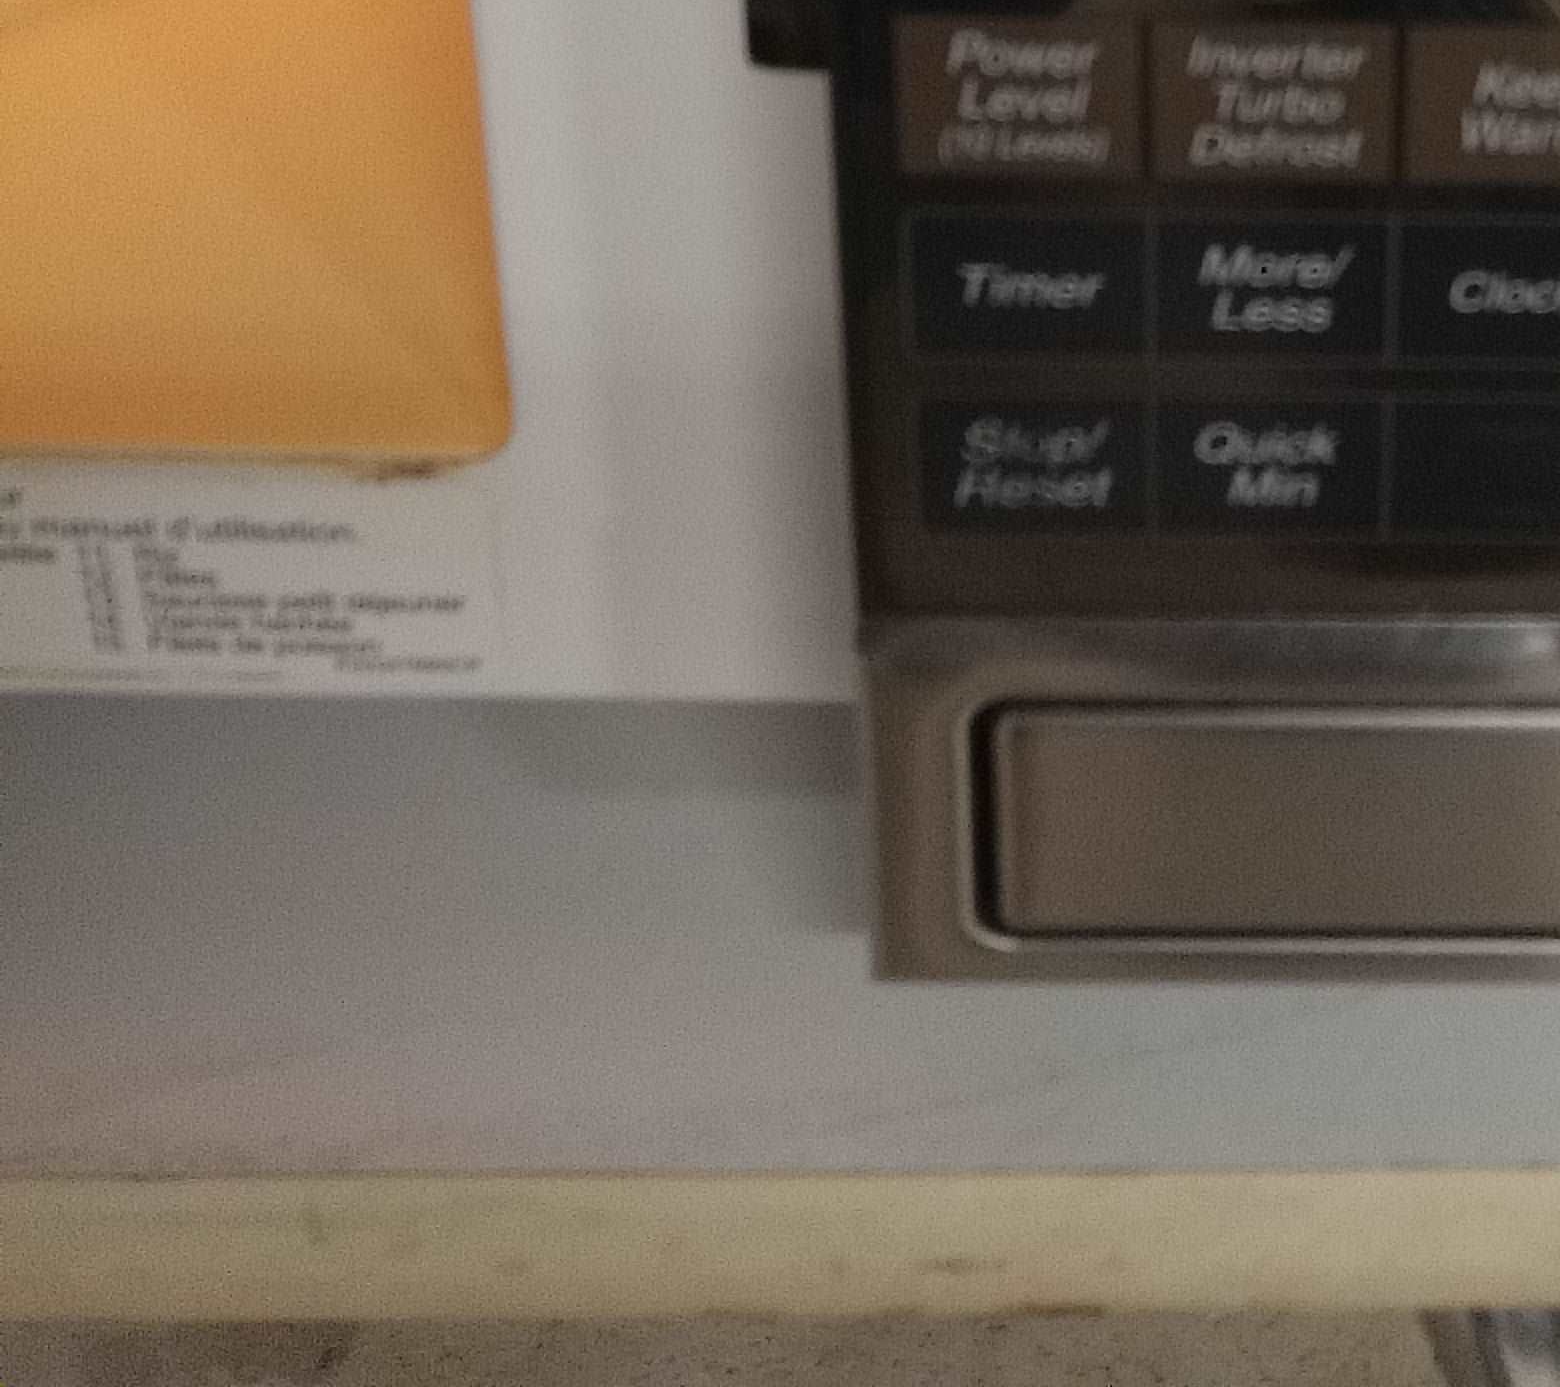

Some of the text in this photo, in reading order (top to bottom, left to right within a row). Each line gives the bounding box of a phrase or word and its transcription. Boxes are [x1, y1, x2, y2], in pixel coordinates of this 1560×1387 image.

[946, 28, 1100, 79] Power
[958, 77, 1092, 125] Level
[1214, 81, 1347, 126] Turbo
[957, 261, 1106, 311] Timer
[1212, 290, 1334, 334] Less
[1194, 420, 1340, 467] Quick
[1228, 466, 1320, 507] Min
